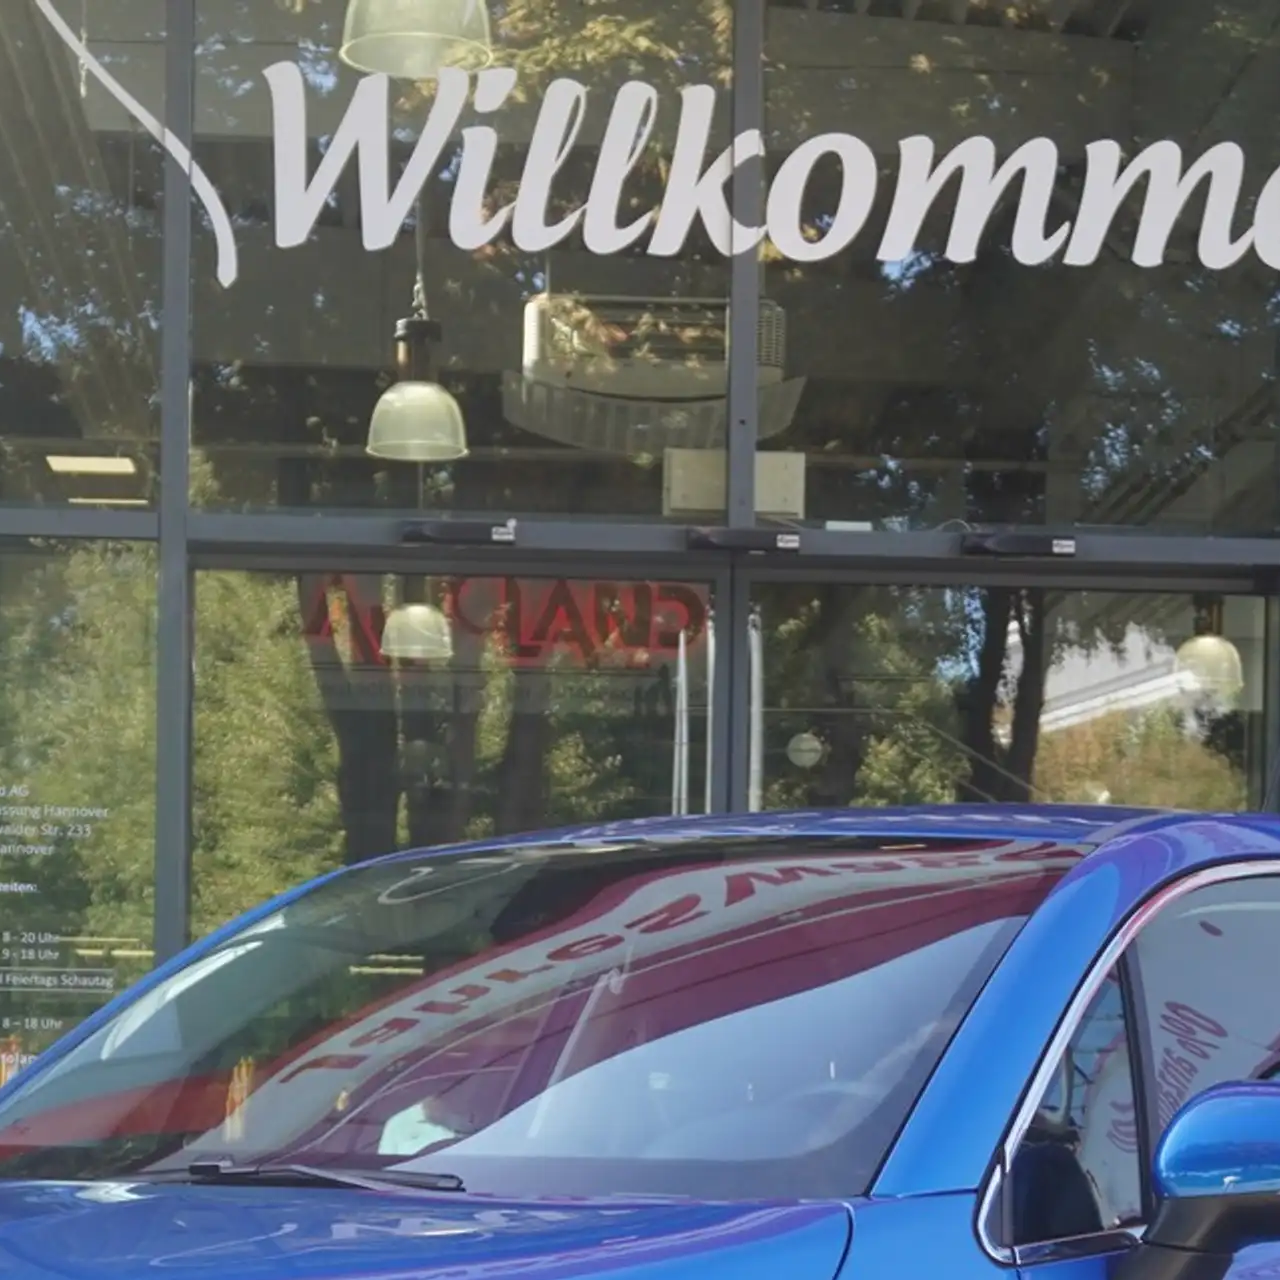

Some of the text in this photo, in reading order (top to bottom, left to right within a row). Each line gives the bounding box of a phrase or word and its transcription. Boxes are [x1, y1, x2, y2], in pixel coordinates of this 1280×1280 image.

[303, 574, 709, 667] AOLAND
[8, 784, 29, 797] AG
[44, 805, 109, 818] Hannover
[20, 932, 35, 943] 20
[38, 932, 60, 943] Uhr
[38, 949, 60, 960] Uhr
[2, 1018, 10, 1029] 8
[24, 1018, 38, 1029] 18
[40, 1018, 63, 1030] Uhr
